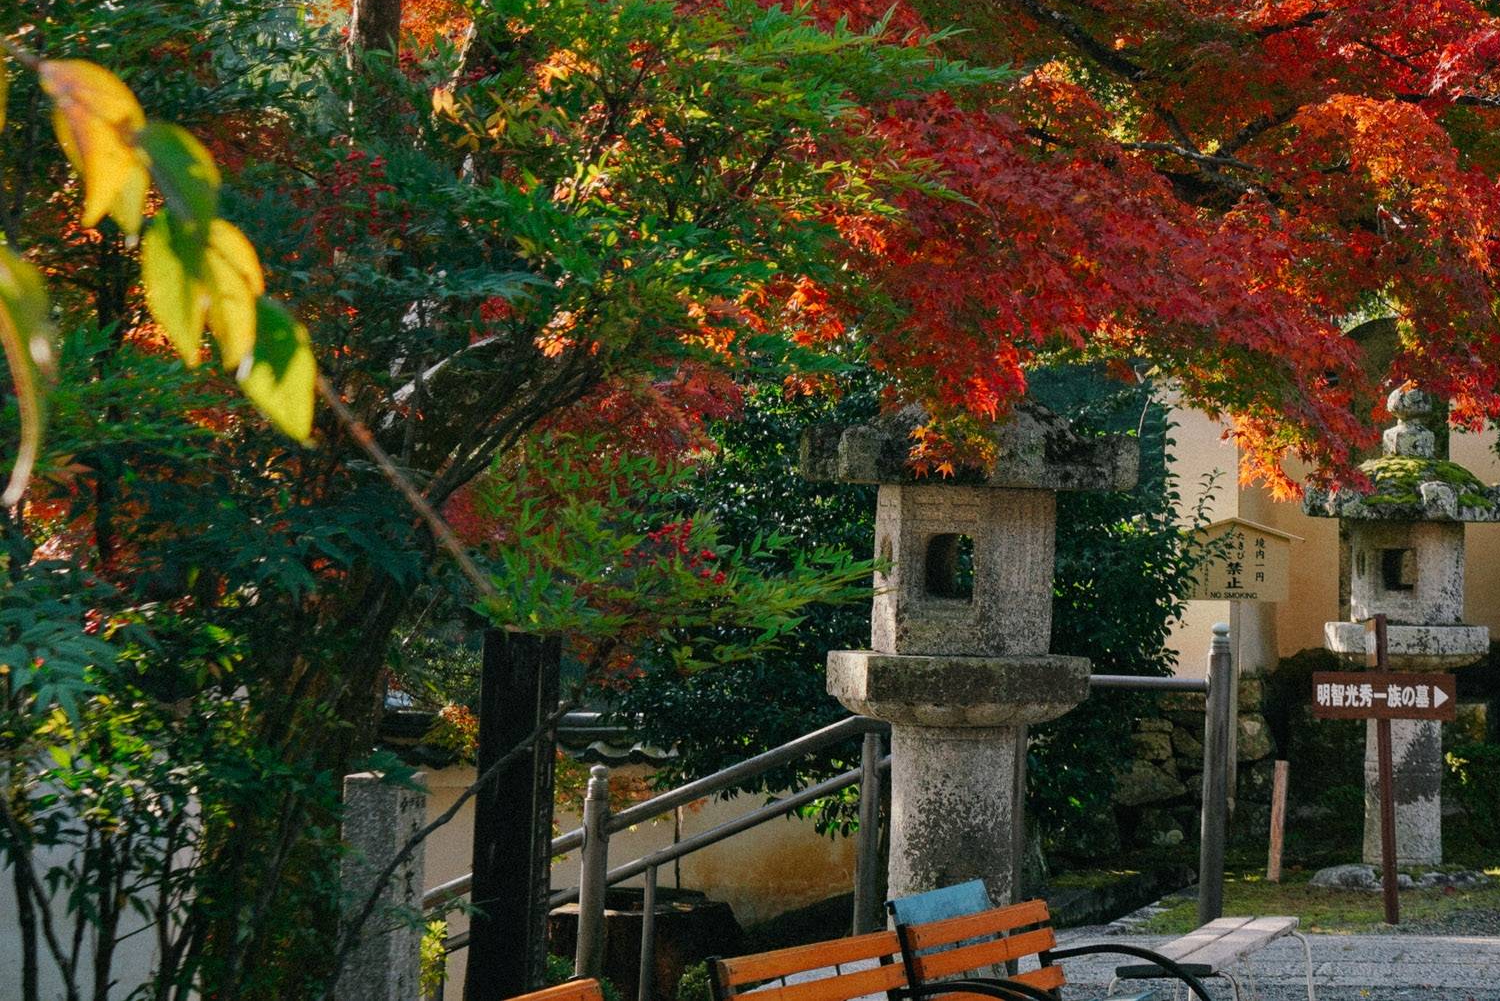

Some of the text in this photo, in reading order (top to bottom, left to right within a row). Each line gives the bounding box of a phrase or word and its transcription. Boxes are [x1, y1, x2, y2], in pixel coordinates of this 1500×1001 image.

[1316, 682, 1430, 709] 明智光秀一族の墓
